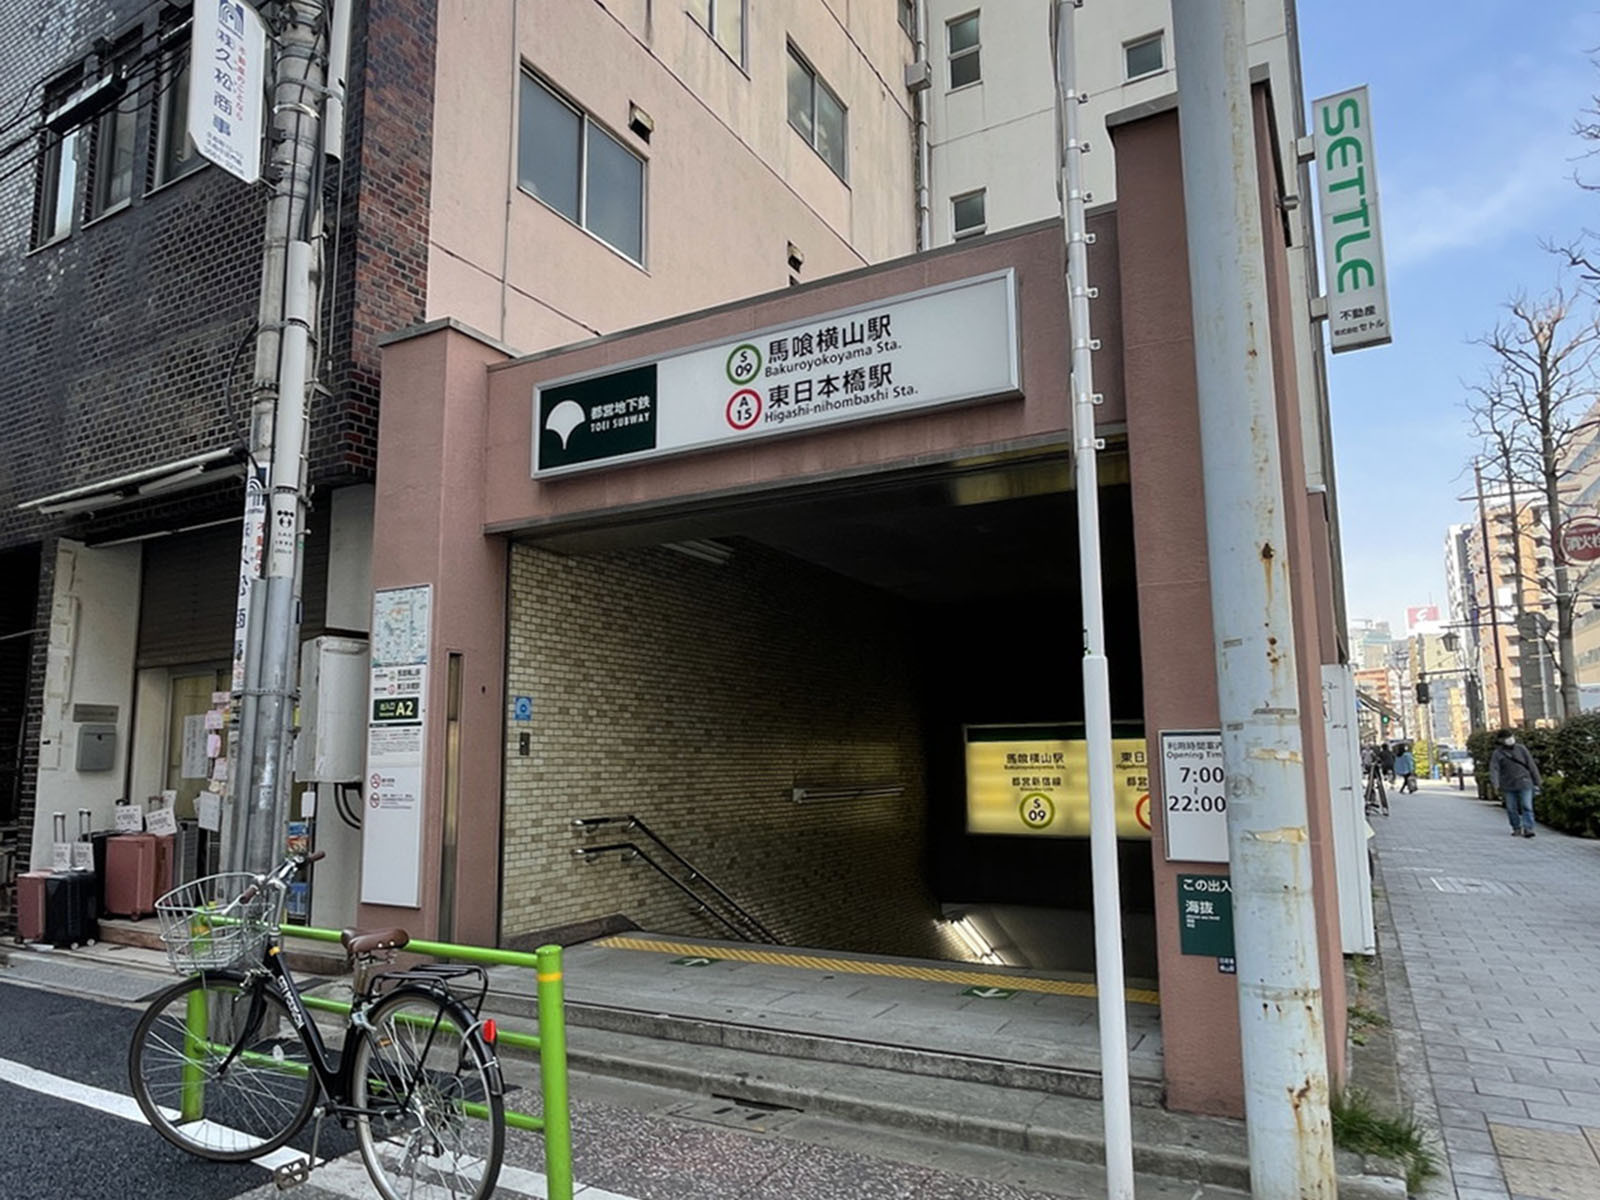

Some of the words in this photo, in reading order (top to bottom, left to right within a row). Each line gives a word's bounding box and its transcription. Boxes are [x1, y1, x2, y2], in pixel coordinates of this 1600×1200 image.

[1322, 97, 1375, 294] SETTLE
[1339, 305, 1376, 320] 不動産
[768, 314, 891, 364] 馬喰横山駅
[739, 351, 748, 363] S
[765, 346, 873, 378] Bakuroyokoyama
[876, 339, 902, 354] Sta.
[735, 363, 753, 378] 09
[768, 362, 893, 409] 東日本橋駅
[591, 395, 650, 420] 都営地下鉄
[739, 396, 749, 408] A
[765, 387, 889, 423] Higashi-nihombashi
[893, 384, 918, 396] Sta.
[591, 420, 610, 433] TOEI
[612, 412, 650, 429] SUBWAY
[736, 408, 752, 422] 15
[395, 701, 413, 716] A2
[1166, 751, 1204, 760] Opening
[1180, 767, 1224, 783] 7:00
[1033, 798, 1041, 809] S
[1168, 796, 1226, 812] 22:00
[1028, 810, 1046, 822] 09
[1183, 878, 1233, 892] この出入
[1185, 899, 1214, 914] 海抜
